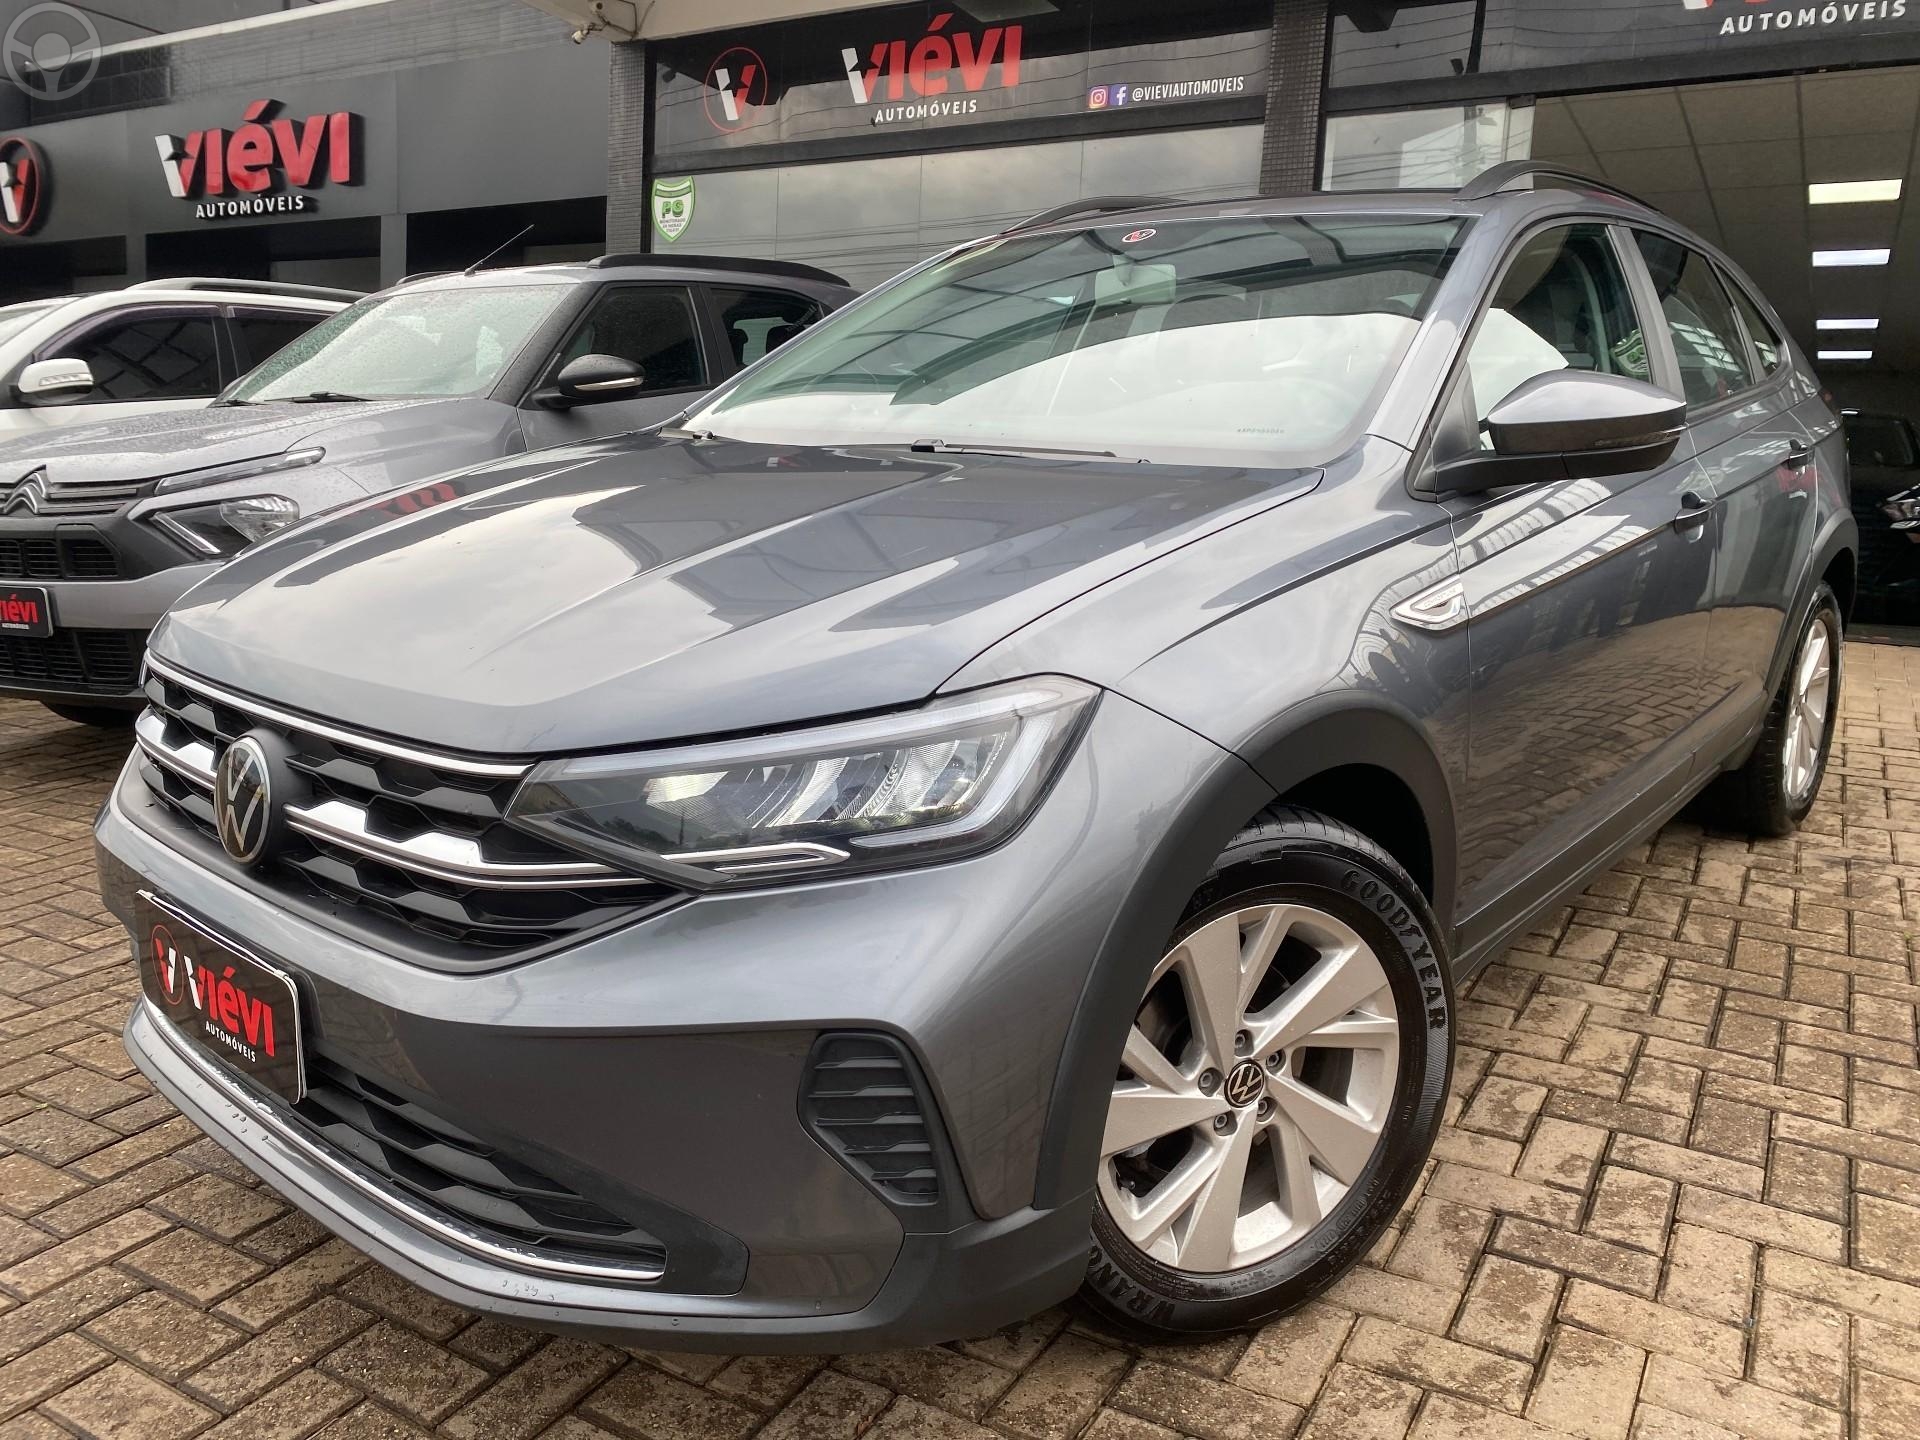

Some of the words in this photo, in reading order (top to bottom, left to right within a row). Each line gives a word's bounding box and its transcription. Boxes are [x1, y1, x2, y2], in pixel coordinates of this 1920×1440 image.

[1719, 0, 1908, 36] AUTOMÓVEIS
[1132, 76, 1245, 102] @VIEVIAUTOMOVEIS
[874, 98, 978, 123] AUTOMÓVEIS
[195, 194, 305, 219] AUTOMÓVEIS
[1341, 868, 1447, 1030] GOODYEAR
[205, 1020, 257, 1064] AUTOMÓVEIS
[1087, 1235, 1176, 1322] WRANG
